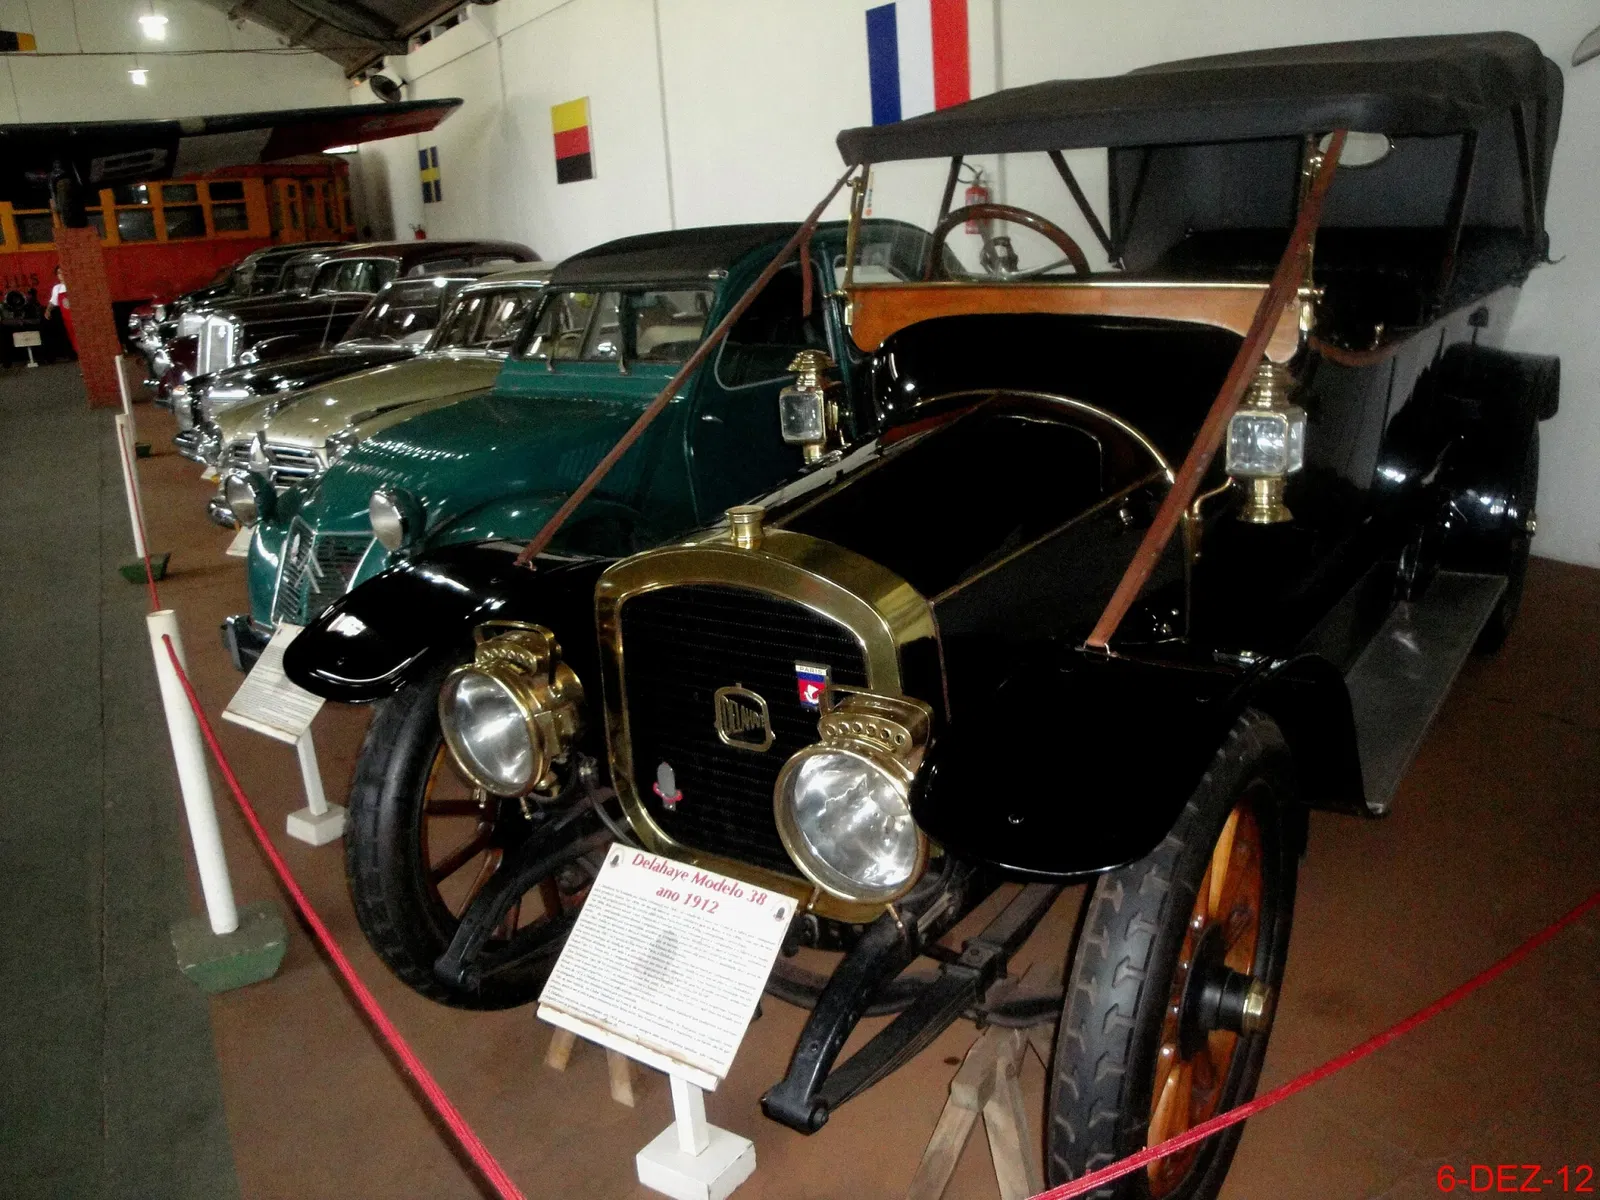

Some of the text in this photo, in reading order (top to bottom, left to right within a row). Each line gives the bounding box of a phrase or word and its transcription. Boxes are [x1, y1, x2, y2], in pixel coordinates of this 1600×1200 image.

[799, 666, 823, 675] PARIS
[631, 852, 768, 906] Delahaye Modelo 38
[656, 887, 719, 914] ano 1912
